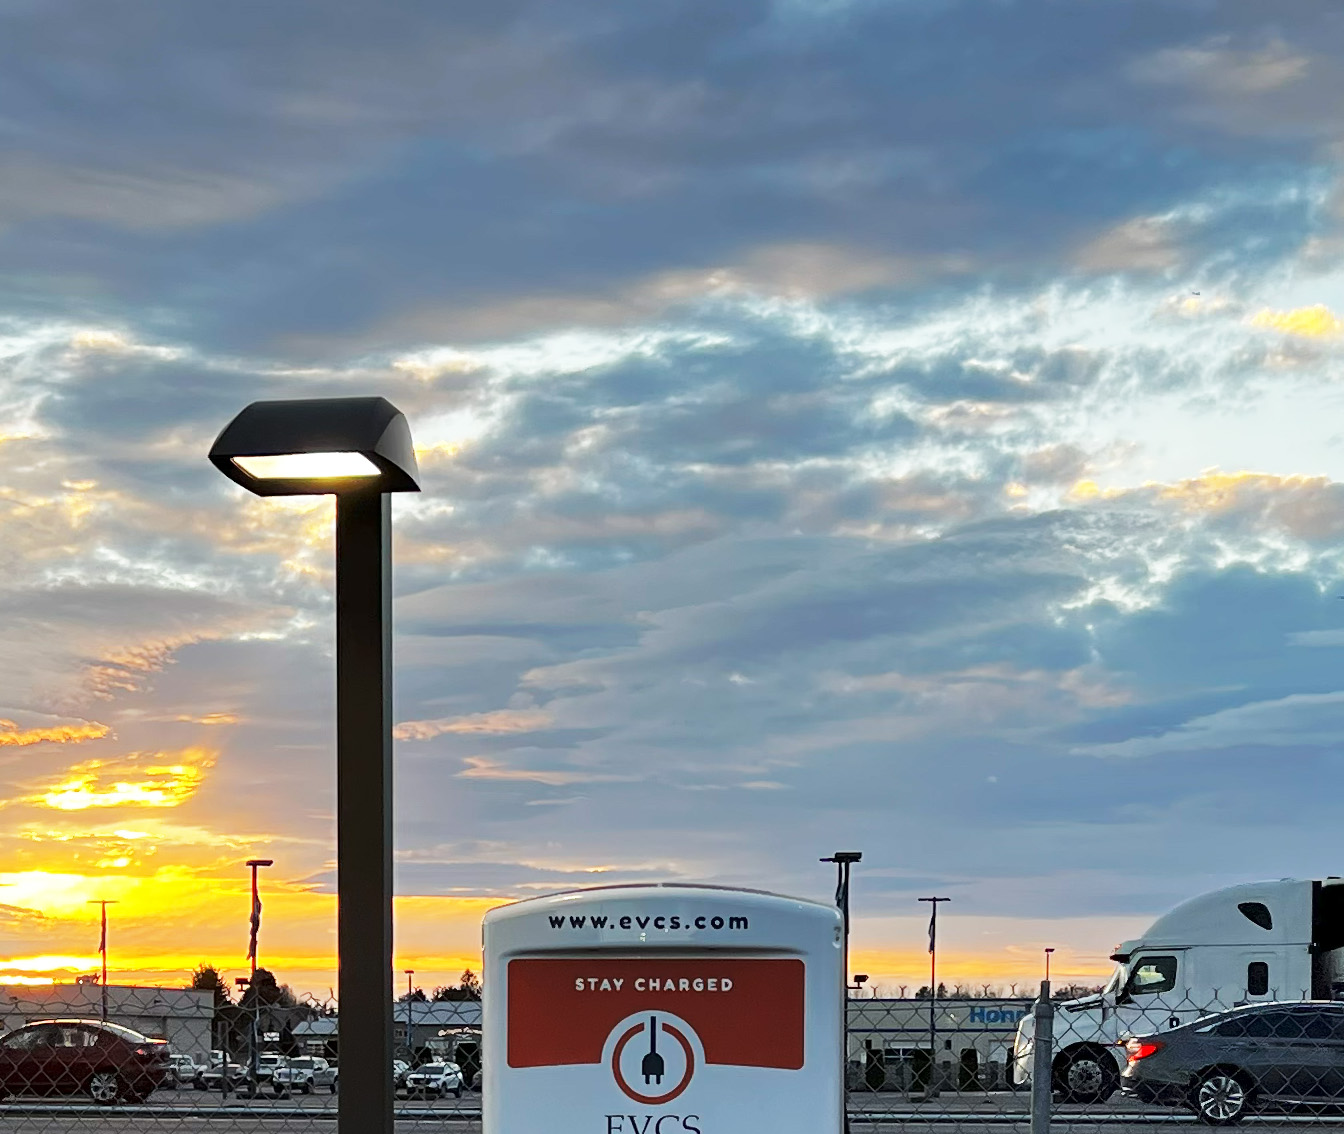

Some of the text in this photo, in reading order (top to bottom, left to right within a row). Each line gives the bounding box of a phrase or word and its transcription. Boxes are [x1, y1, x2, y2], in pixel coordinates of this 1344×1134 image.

[549, 915, 749, 930] www.evcs.com
[575, 977, 733, 991] STAY CHARGED
